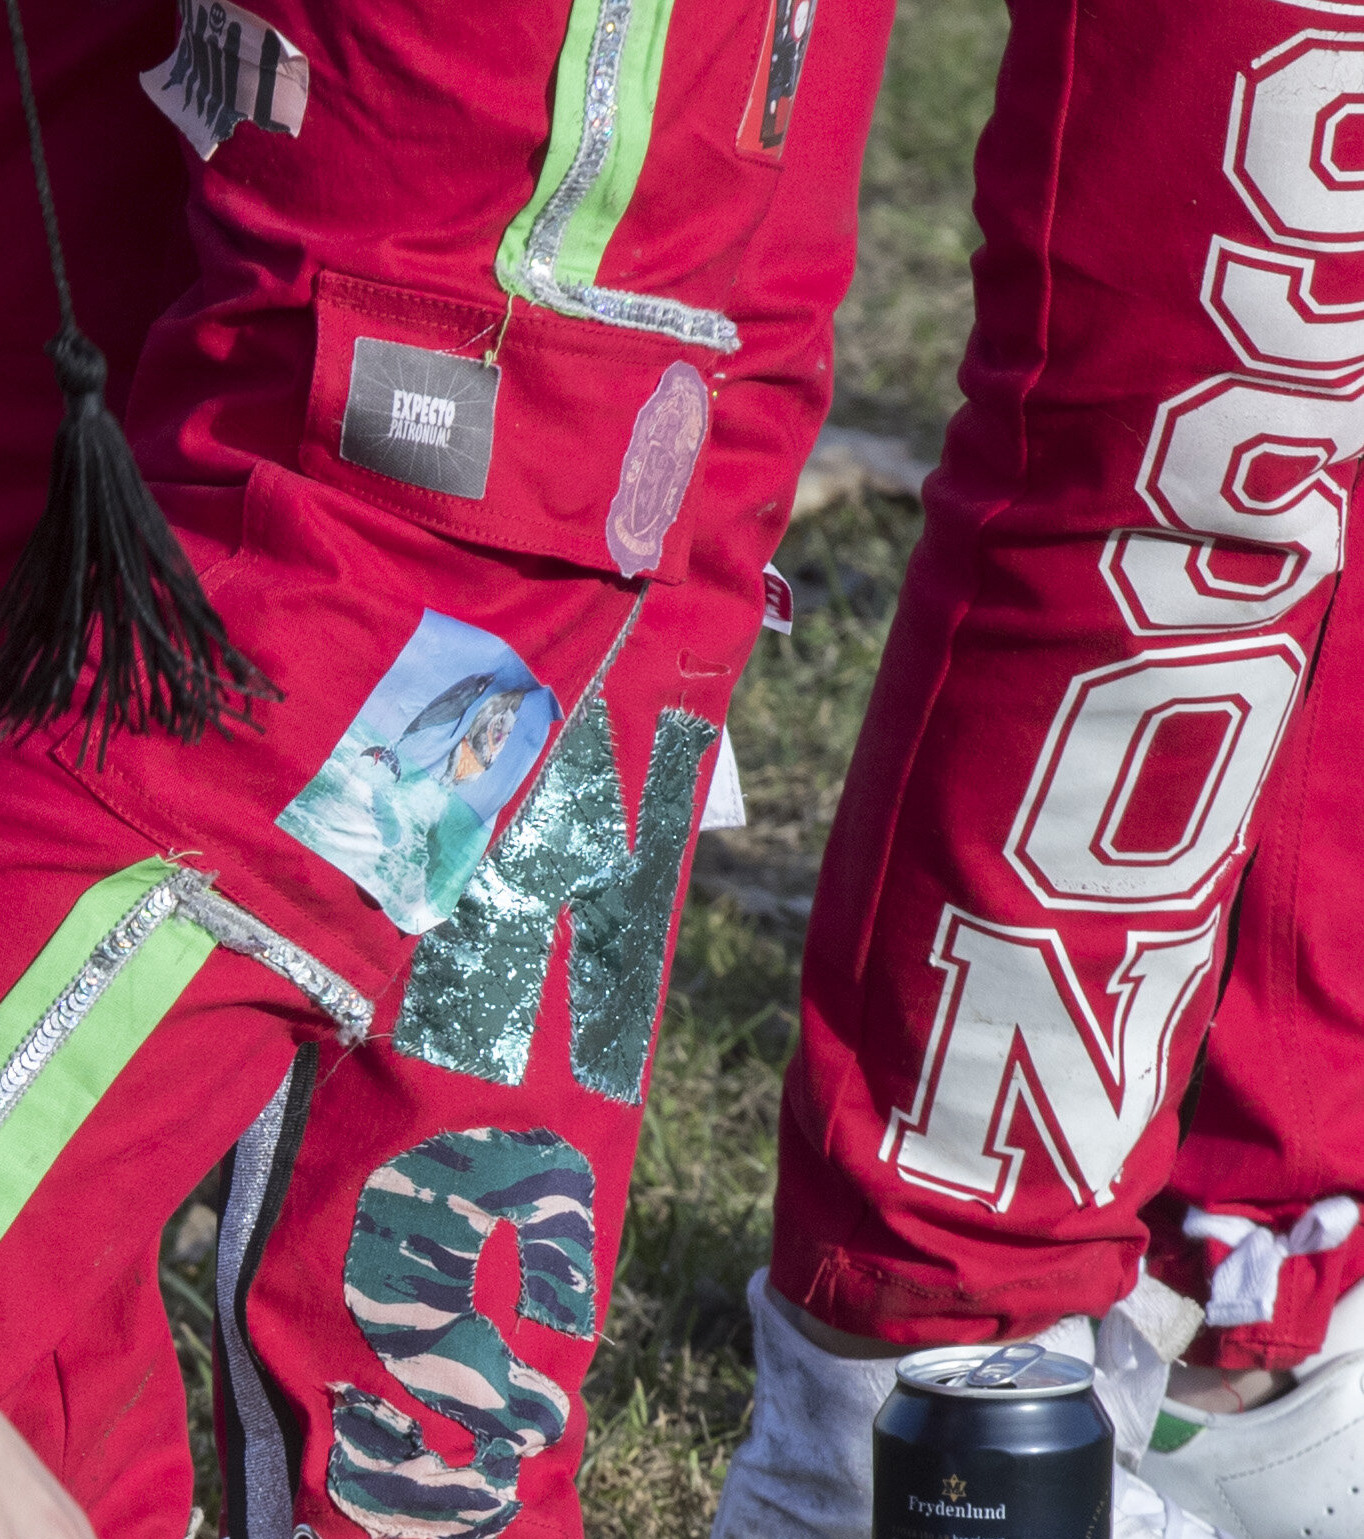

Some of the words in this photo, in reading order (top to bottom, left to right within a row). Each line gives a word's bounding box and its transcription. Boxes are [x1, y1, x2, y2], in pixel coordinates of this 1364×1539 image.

[392, 389, 456, 428] EXPECTO
[388, 418, 452, 448] PATRONUM!
[908, 1495, 1006, 1520] Frydenlund
